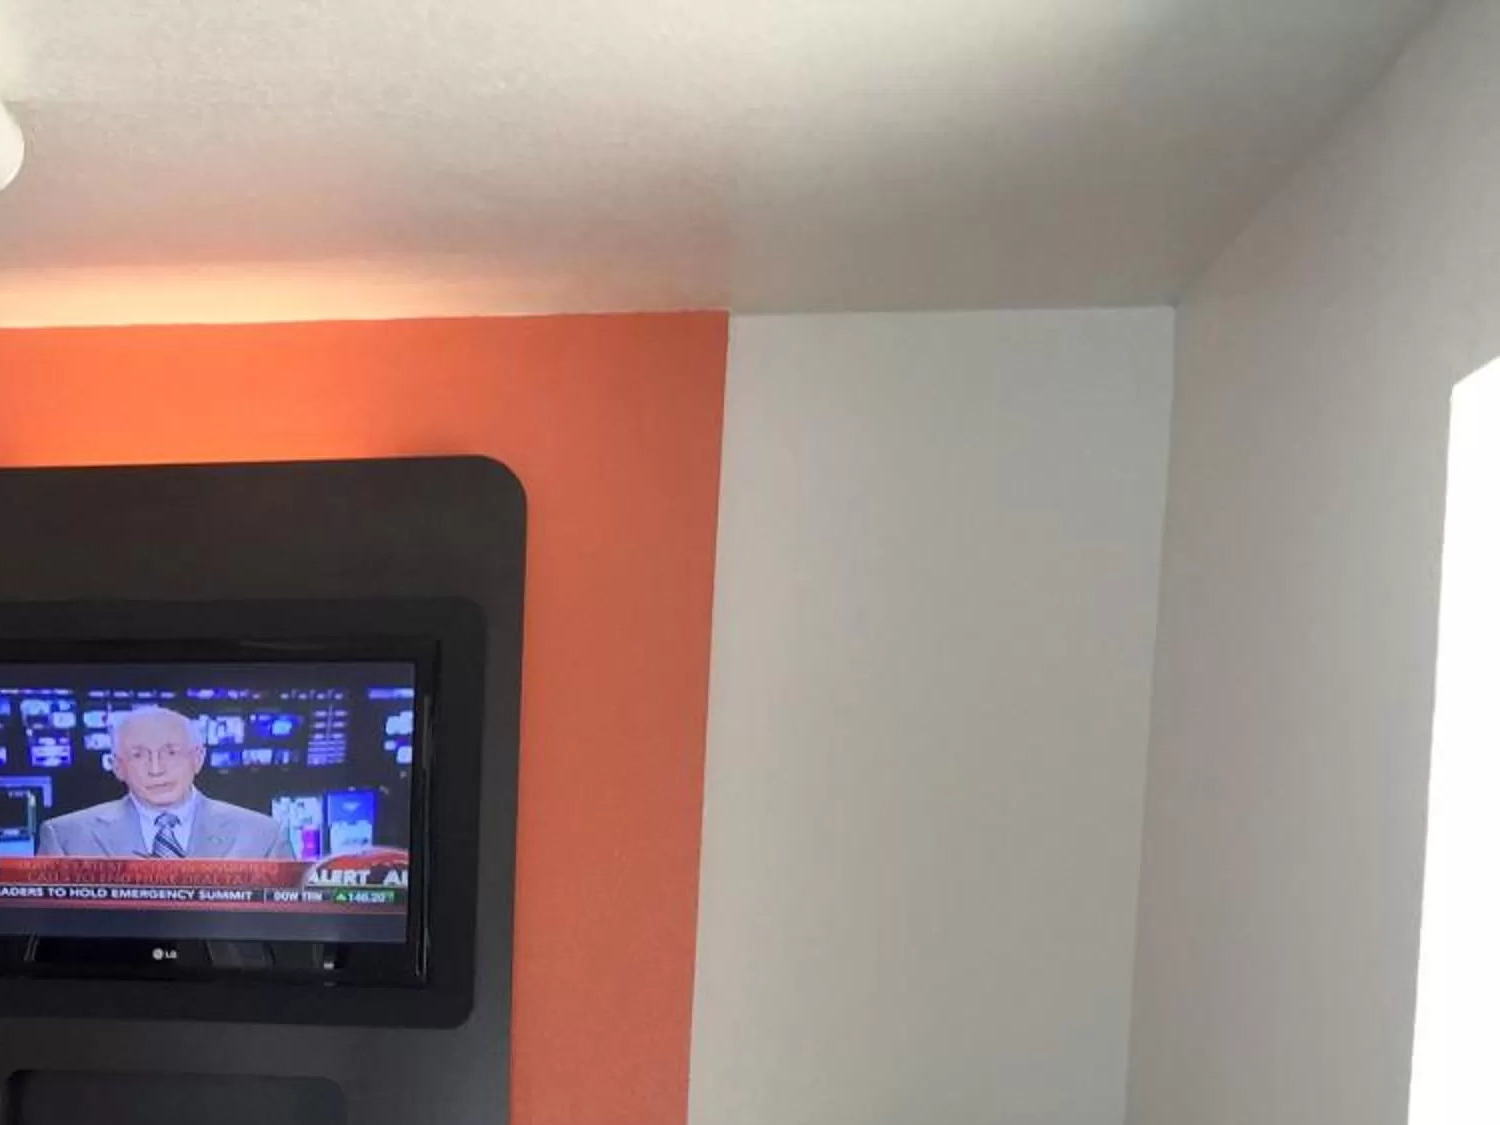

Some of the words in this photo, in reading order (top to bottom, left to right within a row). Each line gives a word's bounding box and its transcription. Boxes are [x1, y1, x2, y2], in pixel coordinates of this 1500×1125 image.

[307, 869, 371, 885] ALERT
[48, 888, 67, 898] TO
[69, 888, 107, 899] HOLD
[111, 888, 197, 900] EMERGENCY
[199, 890, 252, 901] SUMMIT
